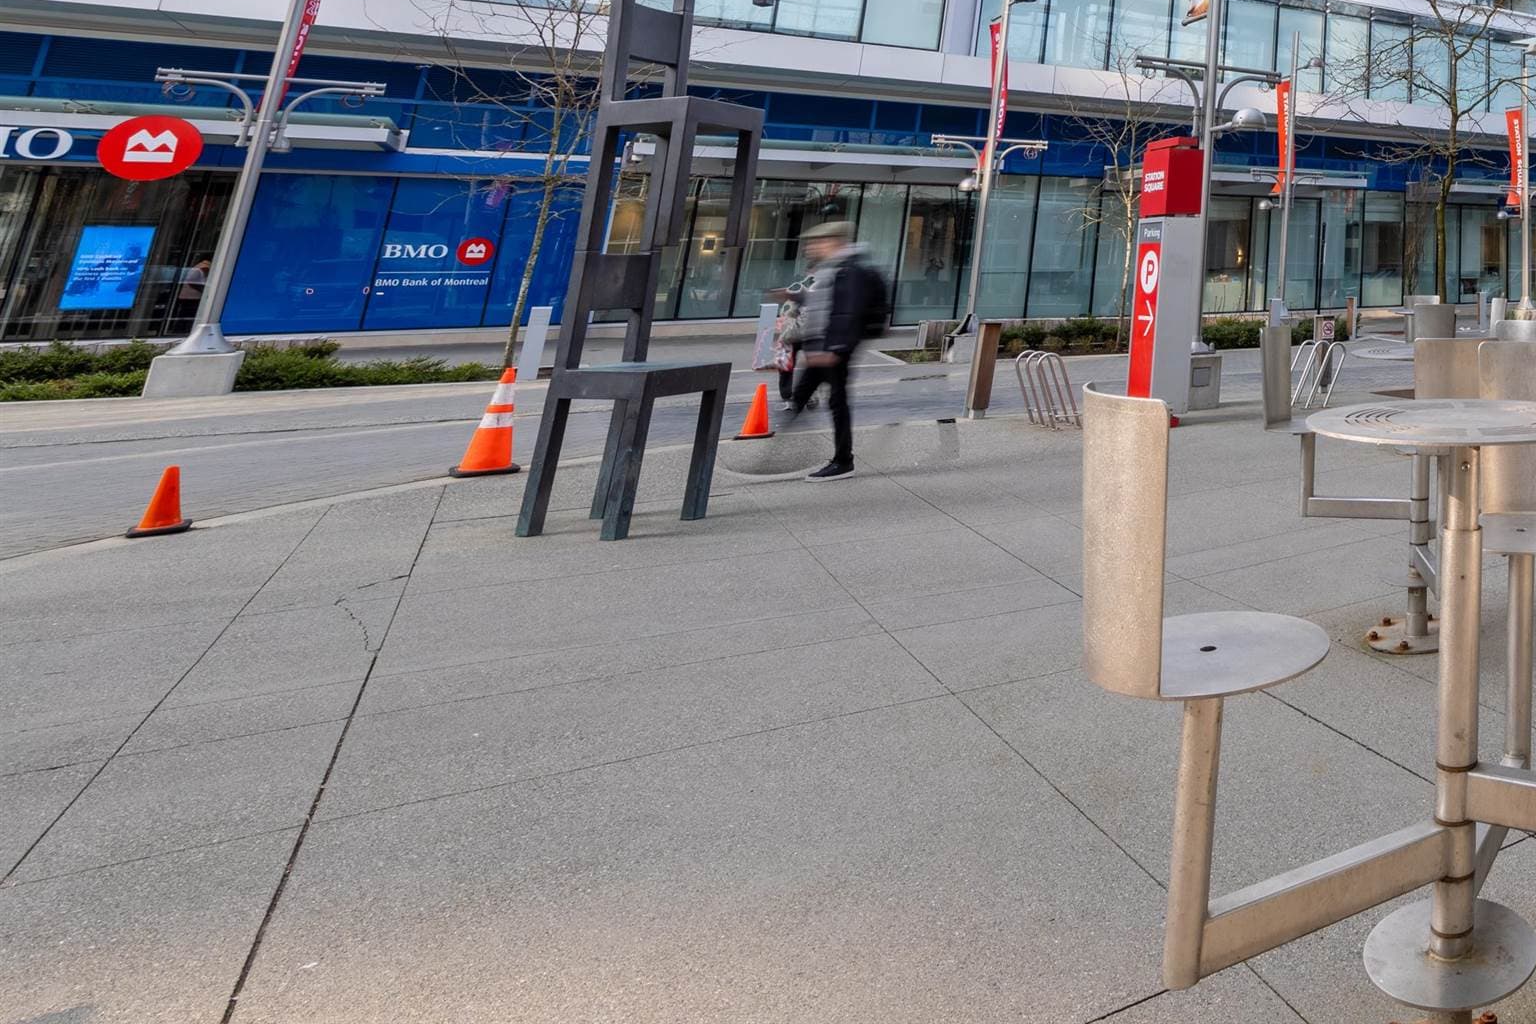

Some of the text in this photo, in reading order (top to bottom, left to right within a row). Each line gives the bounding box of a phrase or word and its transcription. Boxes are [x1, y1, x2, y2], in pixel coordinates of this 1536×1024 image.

[0, 126, 74, 160] O
[1144, 170, 1165, 183] STATION
[1143, 180, 1165, 193] SQUARE
[1143, 228, 1161, 240] Parking
[381, 243, 449, 259] BMO
[374, 277, 489, 287] BMO Bank of Montreal
